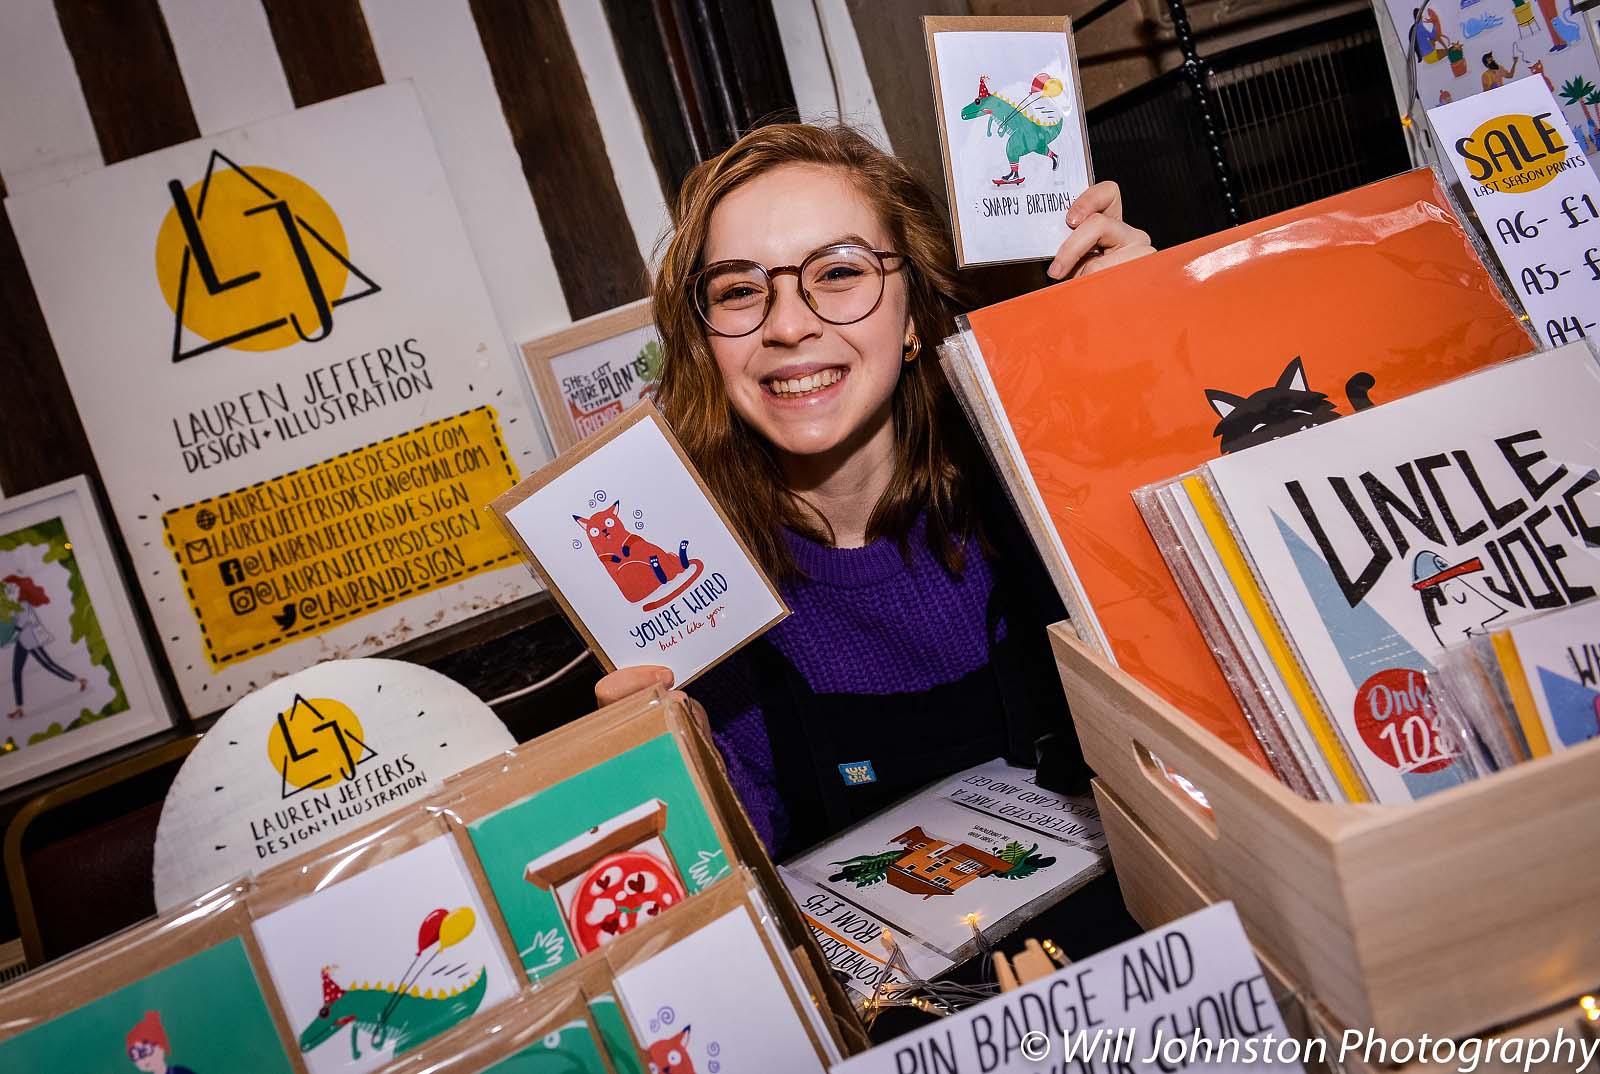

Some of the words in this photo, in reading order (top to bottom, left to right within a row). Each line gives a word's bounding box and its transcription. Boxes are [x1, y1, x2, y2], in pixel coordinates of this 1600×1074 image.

[1455, 112, 1569, 181] SALE
[1473, 181, 1500, 198] LAST
[1502, 168, 1545, 189] SEASON
[1546, 155, 1586, 177] PRINTS
[982, 196, 1019, 217] SNAPPY
[1026, 191, 1072, 215] BIRTHDAY
[1559, 193, 1600, 229] £1
[173, 383, 289, 448] LAUREN
[303, 338, 426, 405] JEFFERIS
[570, 384, 598, 405] MORE
[599, 355, 649, 399] PLANTS
[217, 424, 470, 525] LAURENJEFFERISDESIGN.COM
[211, 445, 490, 557] LAURENJEFFERISDESIGN@GMAIL.COM
[1285, 429, 1569, 609] UNCLE
[245, 481, 470, 577] @LAURENJEFFERISDESIGN
[255, 508, 481, 605] @LAURENJEFFERISDESIGN
[299, 544, 466, 621] @LAURENJDESIGN
[629, 603, 687, 648] YOU'RE
[682, 572, 728, 614] WEIRD
[658, 636, 678, 651] but
[678, 631, 684, 640] I
[686, 621, 705, 635] like
[706, 605, 726, 628] you
[1366, 672, 1437, 722] Only
[250, 793, 331, 841] LAUREN
[339, 753, 415, 804] JEFFERIS
[951, 788, 965, 797] A
[961, 792, 997, 809] TAKE
[962, 775, 992, 787] GET
[988, 781, 1021, 795] AND
[1018, 791, 1059, 808] CARD
[999, 803, 1088, 836] INTERESTED,
[801, 894, 845, 917] £45
[831, 910, 882, 944] FROM
[970, 968, 1104, 1074] BADGE
[1122, 931, 1194, 1013] AND
[1150, 974, 1274, 1074] CHOICE
